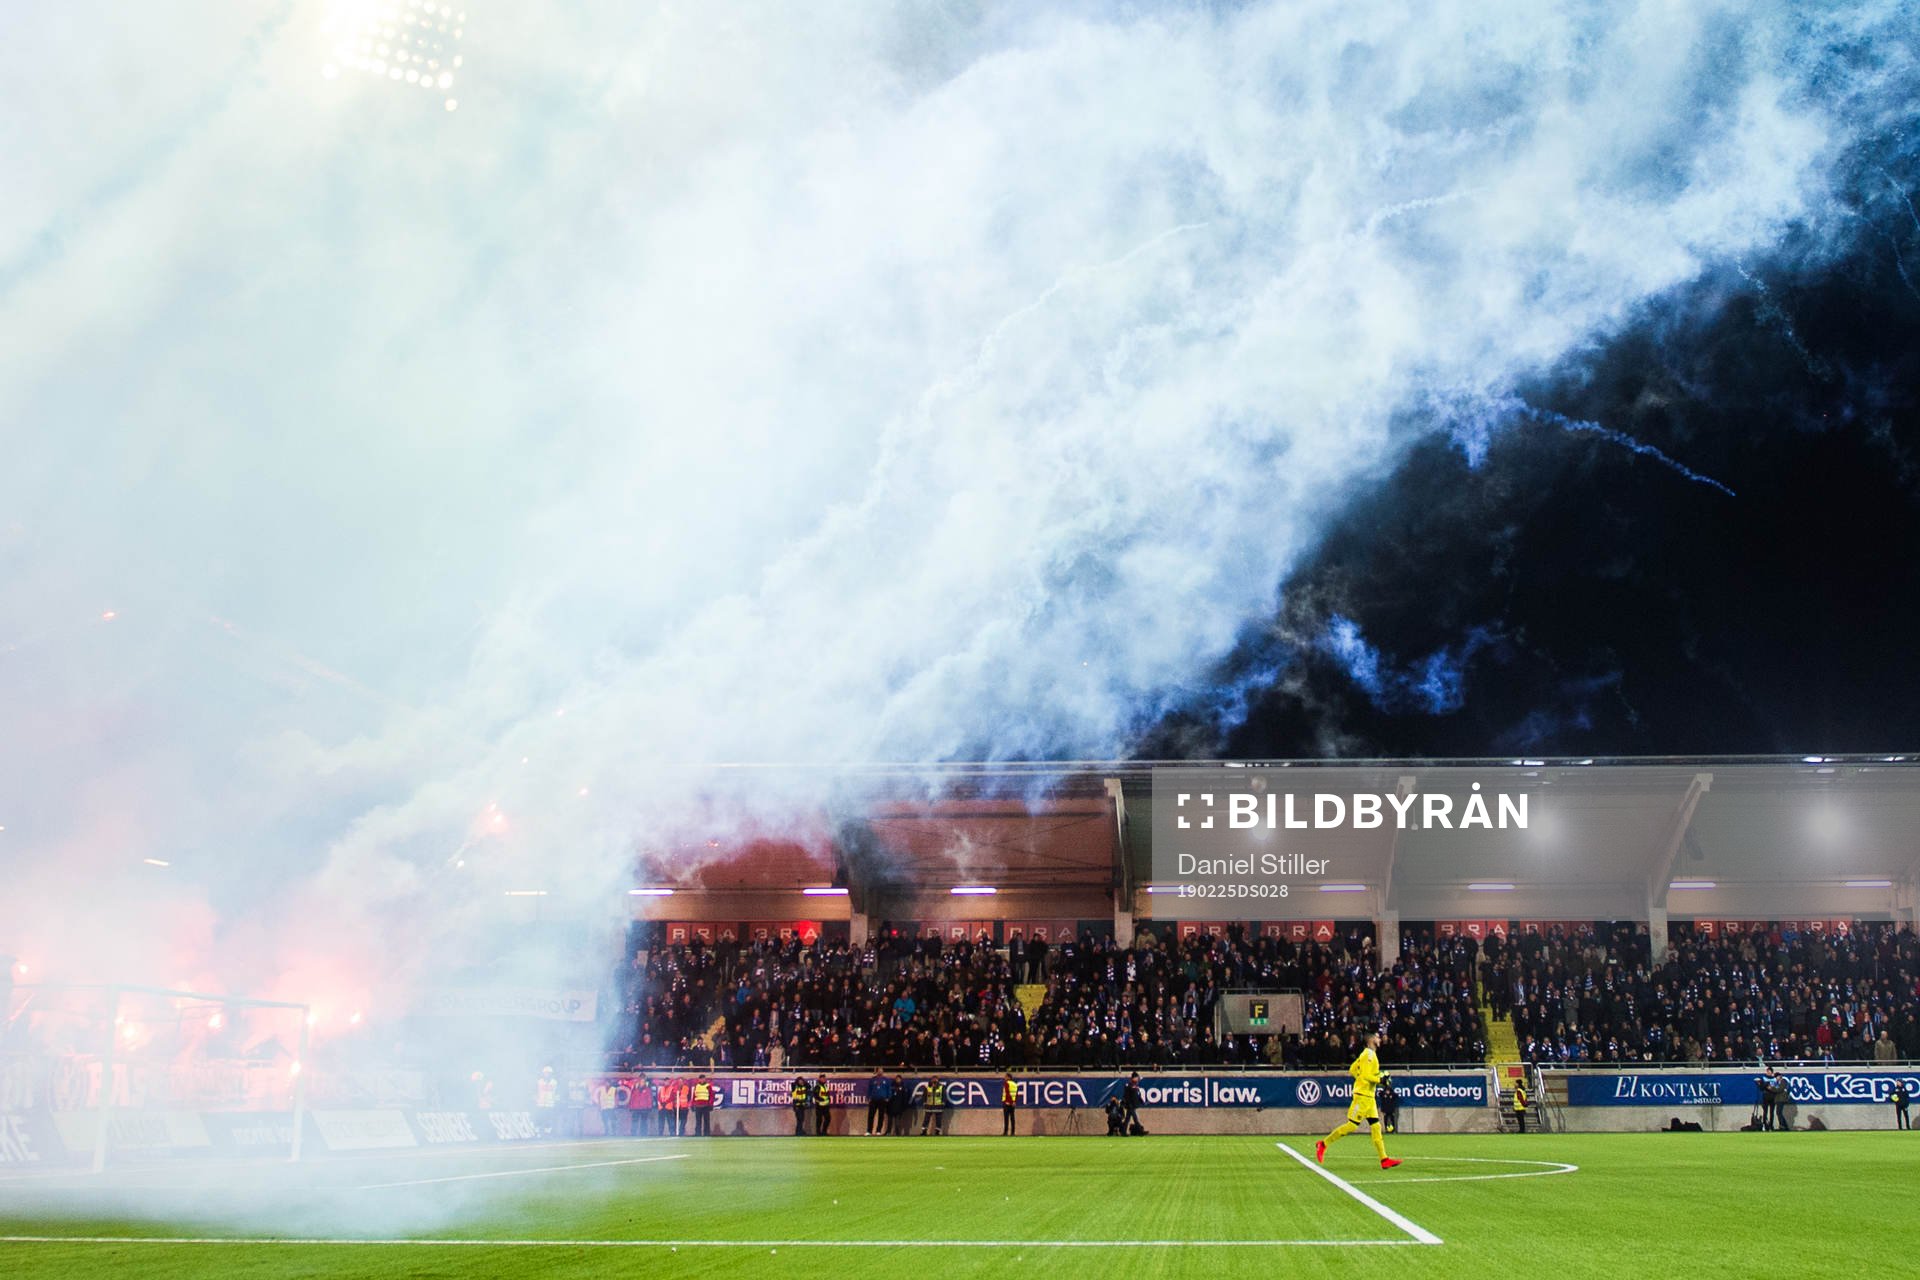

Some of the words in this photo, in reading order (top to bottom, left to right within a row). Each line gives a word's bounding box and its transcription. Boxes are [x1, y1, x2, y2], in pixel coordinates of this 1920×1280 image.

[1254, 1005, 1264, 1018] F
[909, 1081, 990, 1105] AEA
[1413, 1083, 1482, 1100] Göteborg
[1640, 1082, 1722, 1098] KONTAKT
